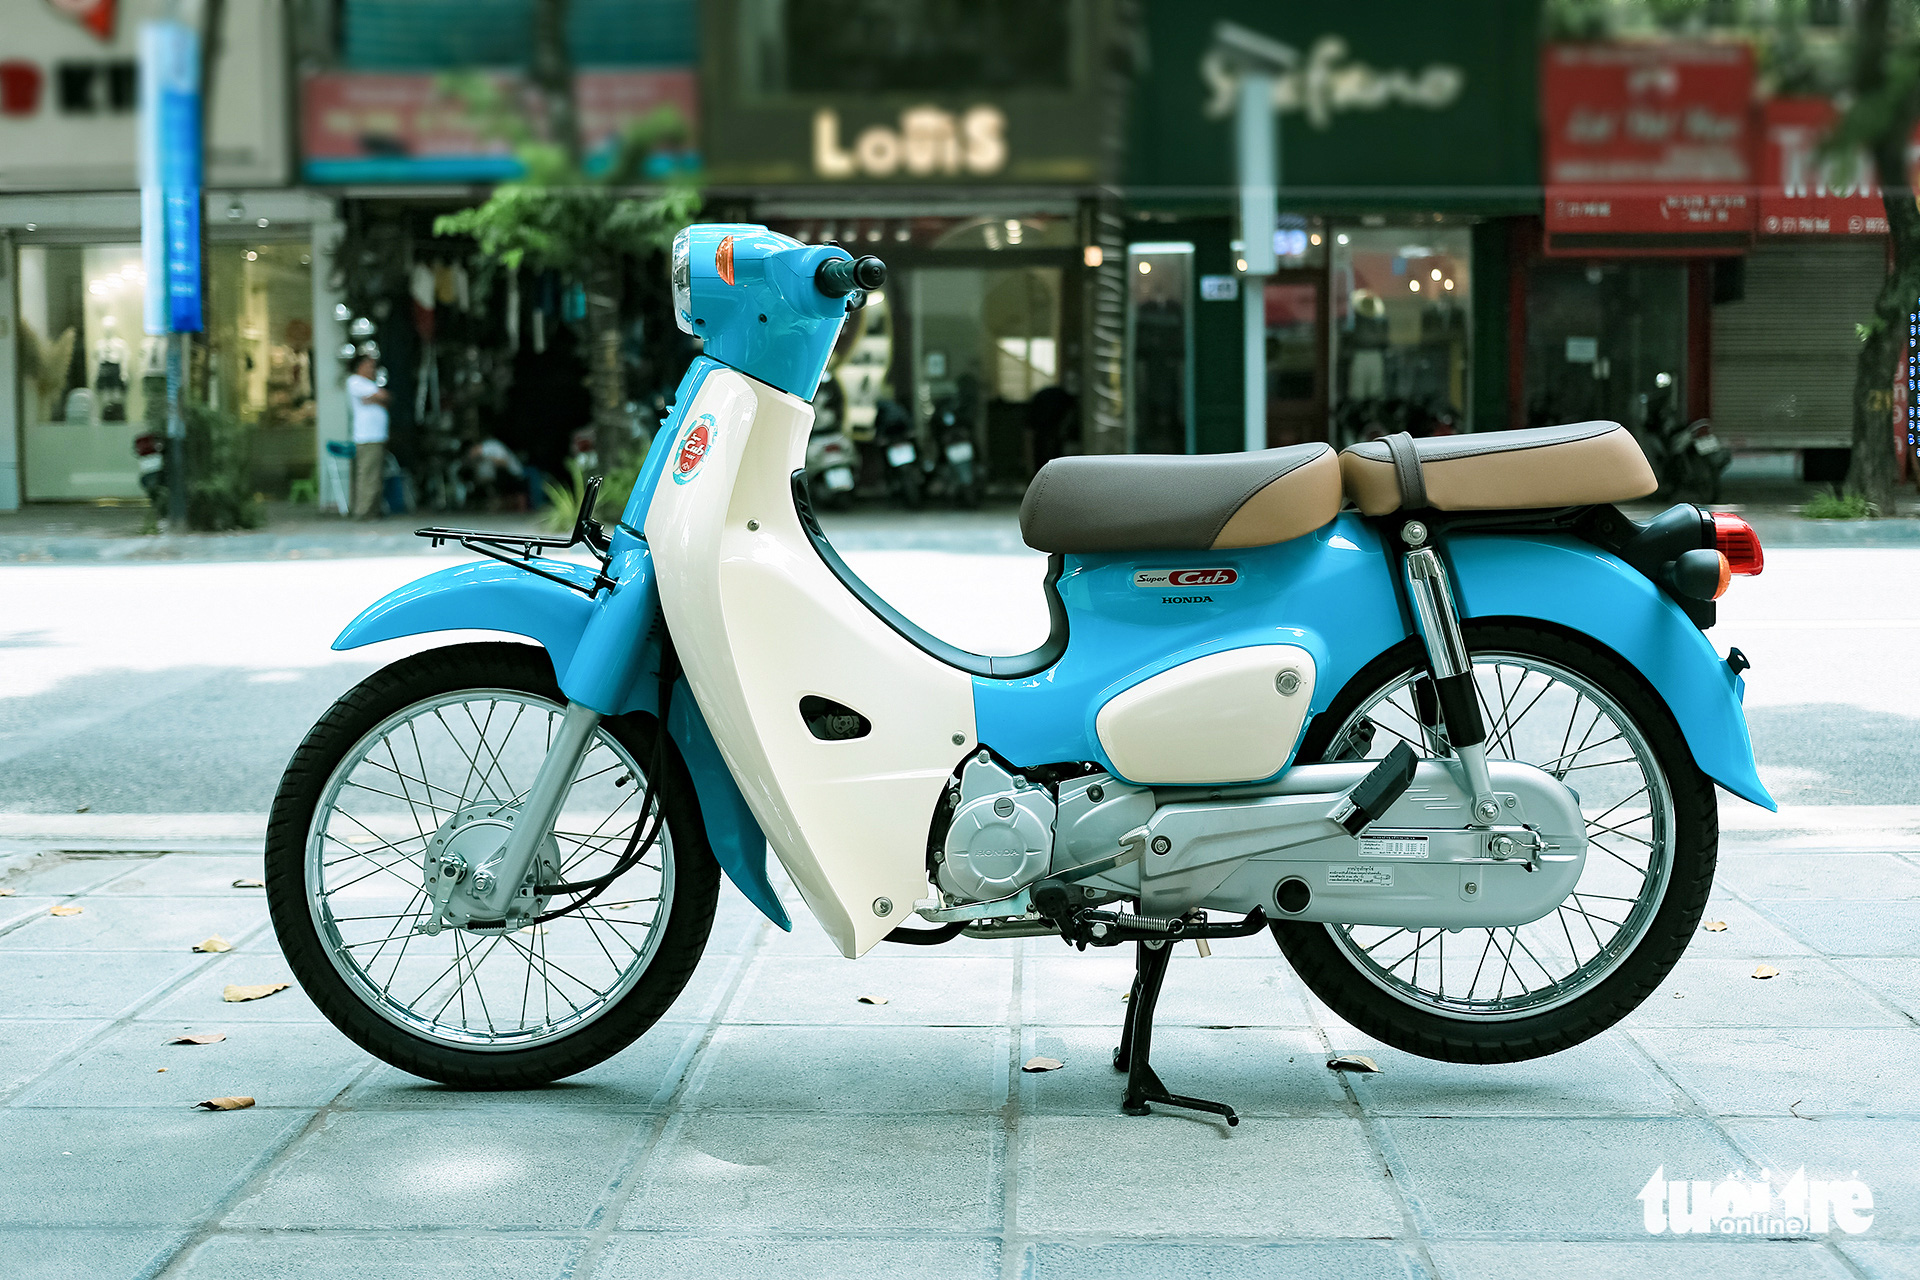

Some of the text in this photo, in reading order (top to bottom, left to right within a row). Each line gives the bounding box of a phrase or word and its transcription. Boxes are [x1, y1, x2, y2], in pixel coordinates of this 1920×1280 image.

[685, 440, 705, 456] Cub
[1137, 571, 1229, 584] Super Cub
[1162, 596, 1213, 604] HONDA
[975, 849, 1020, 857] HONDA
